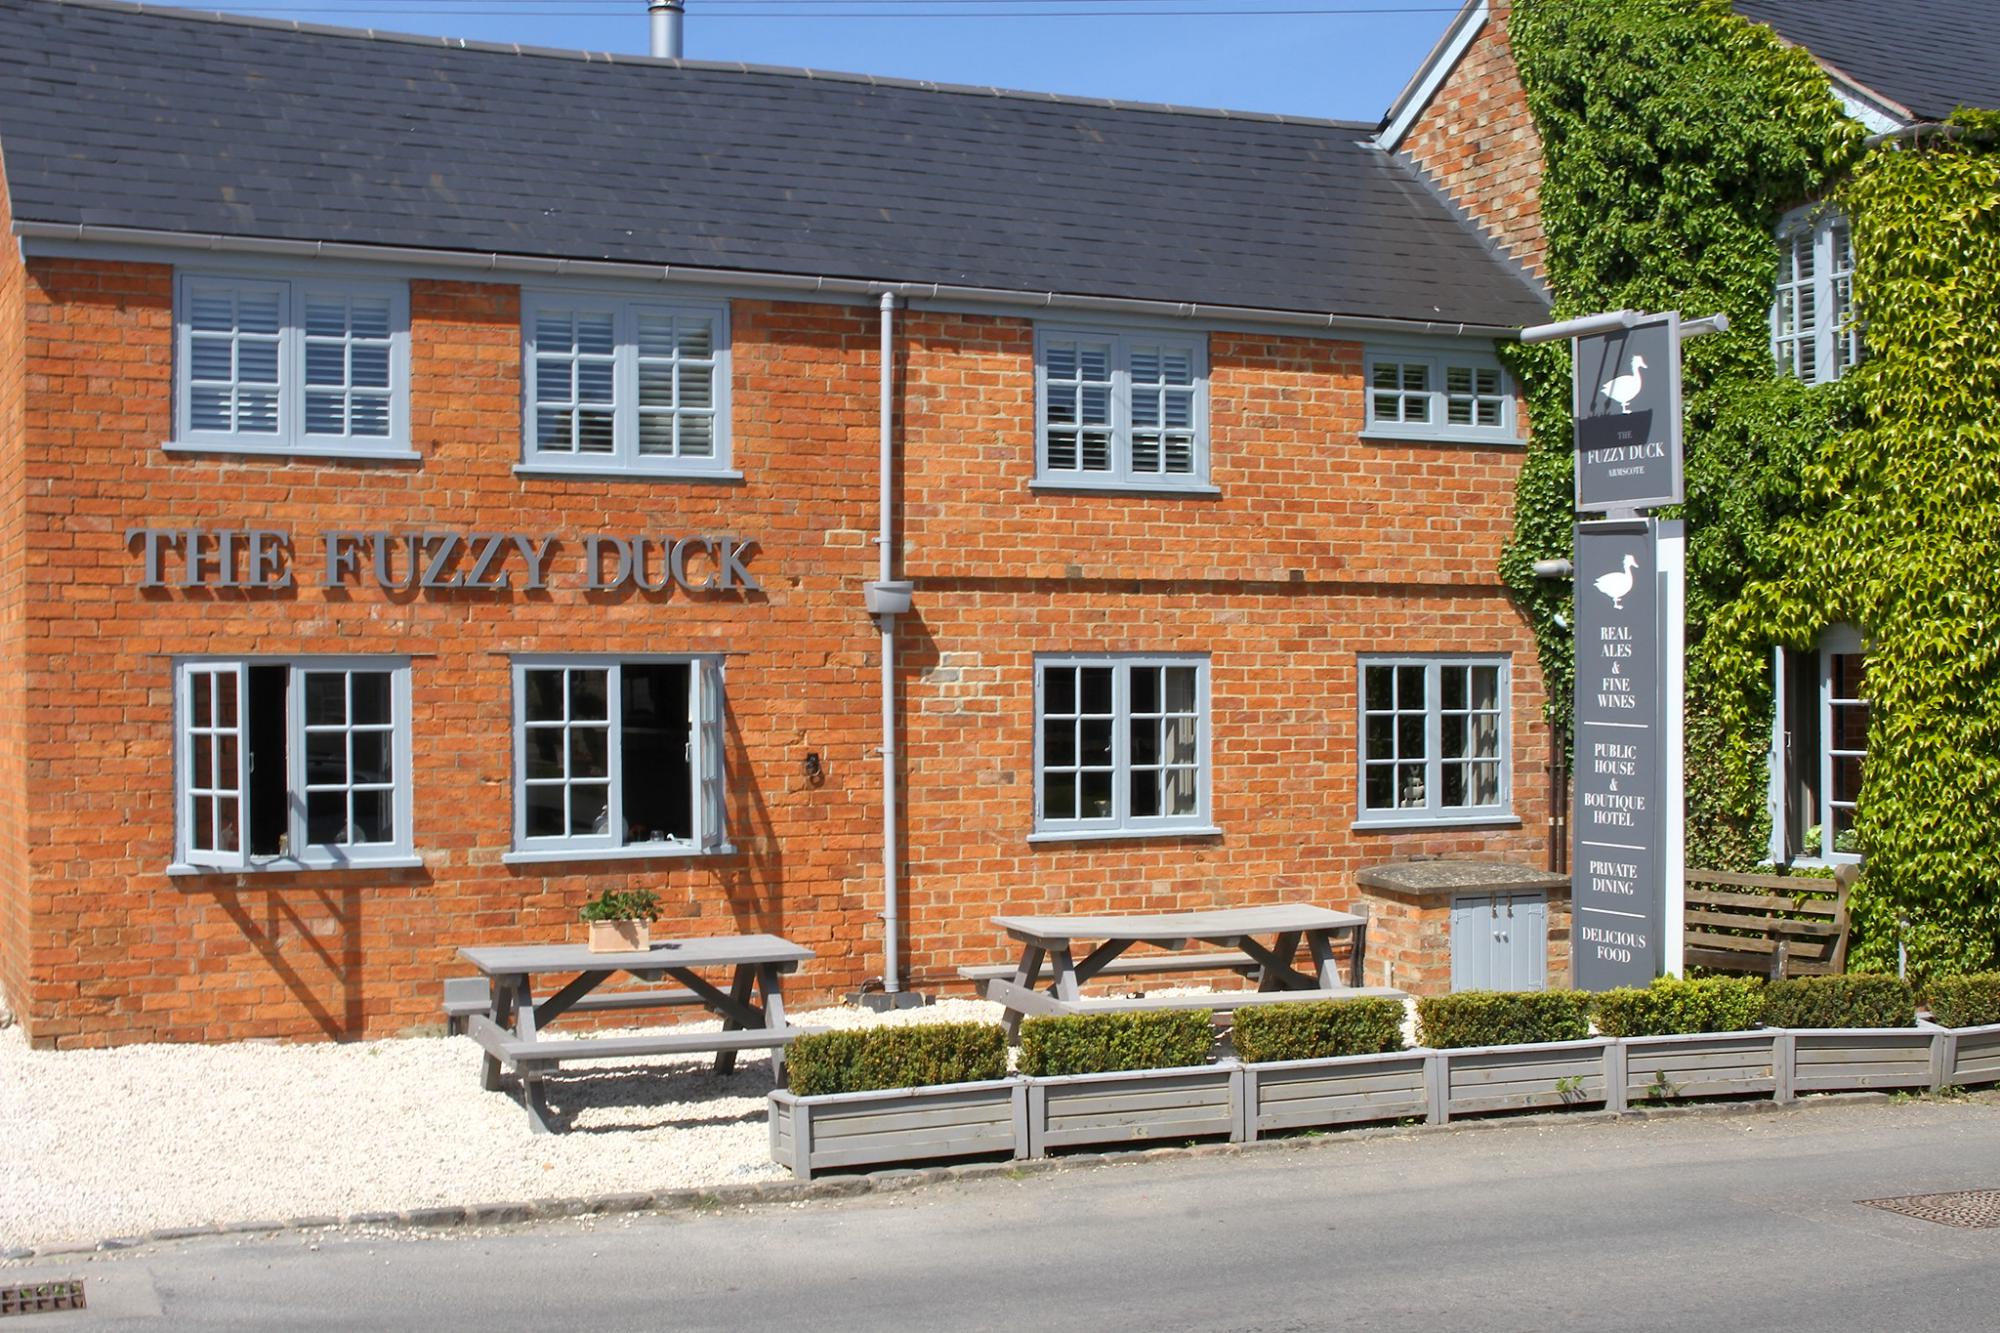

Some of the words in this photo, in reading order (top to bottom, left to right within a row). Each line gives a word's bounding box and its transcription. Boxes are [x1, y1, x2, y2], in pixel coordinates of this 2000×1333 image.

[1617, 430, 1633, 440] THE
[1587, 446, 1627, 465] FUZZY
[1629, 442, 1665, 460] DUCK
[125, 527, 292, 587] THE
[320, 529, 558, 589] FUZZY
[578, 532, 763, 592] DUCK
[1600, 626, 1632, 641] REAL
[1600, 643, 1632, 658] ALES
[1611, 661, 1621, 675] &
[1602, 677, 1630, 692] FINE
[1597, 694, 1636, 709] WINES
[1594, 743, 1637, 760] PUBLIC
[1594, 760, 1635, 776] HOUSE
[1609, 778, 1619, 792] &
[1584, 793, 1645, 812] BOUTIQUE
[1593, 810, 1634, 827] HOTEL
[1589, 860, 1637, 879] PRIVATE
[1592, 877, 1634, 896] DINING
[1582, 926, 1646, 949] DELICIOUS
[1597, 945, 1631, 963] FOOD
